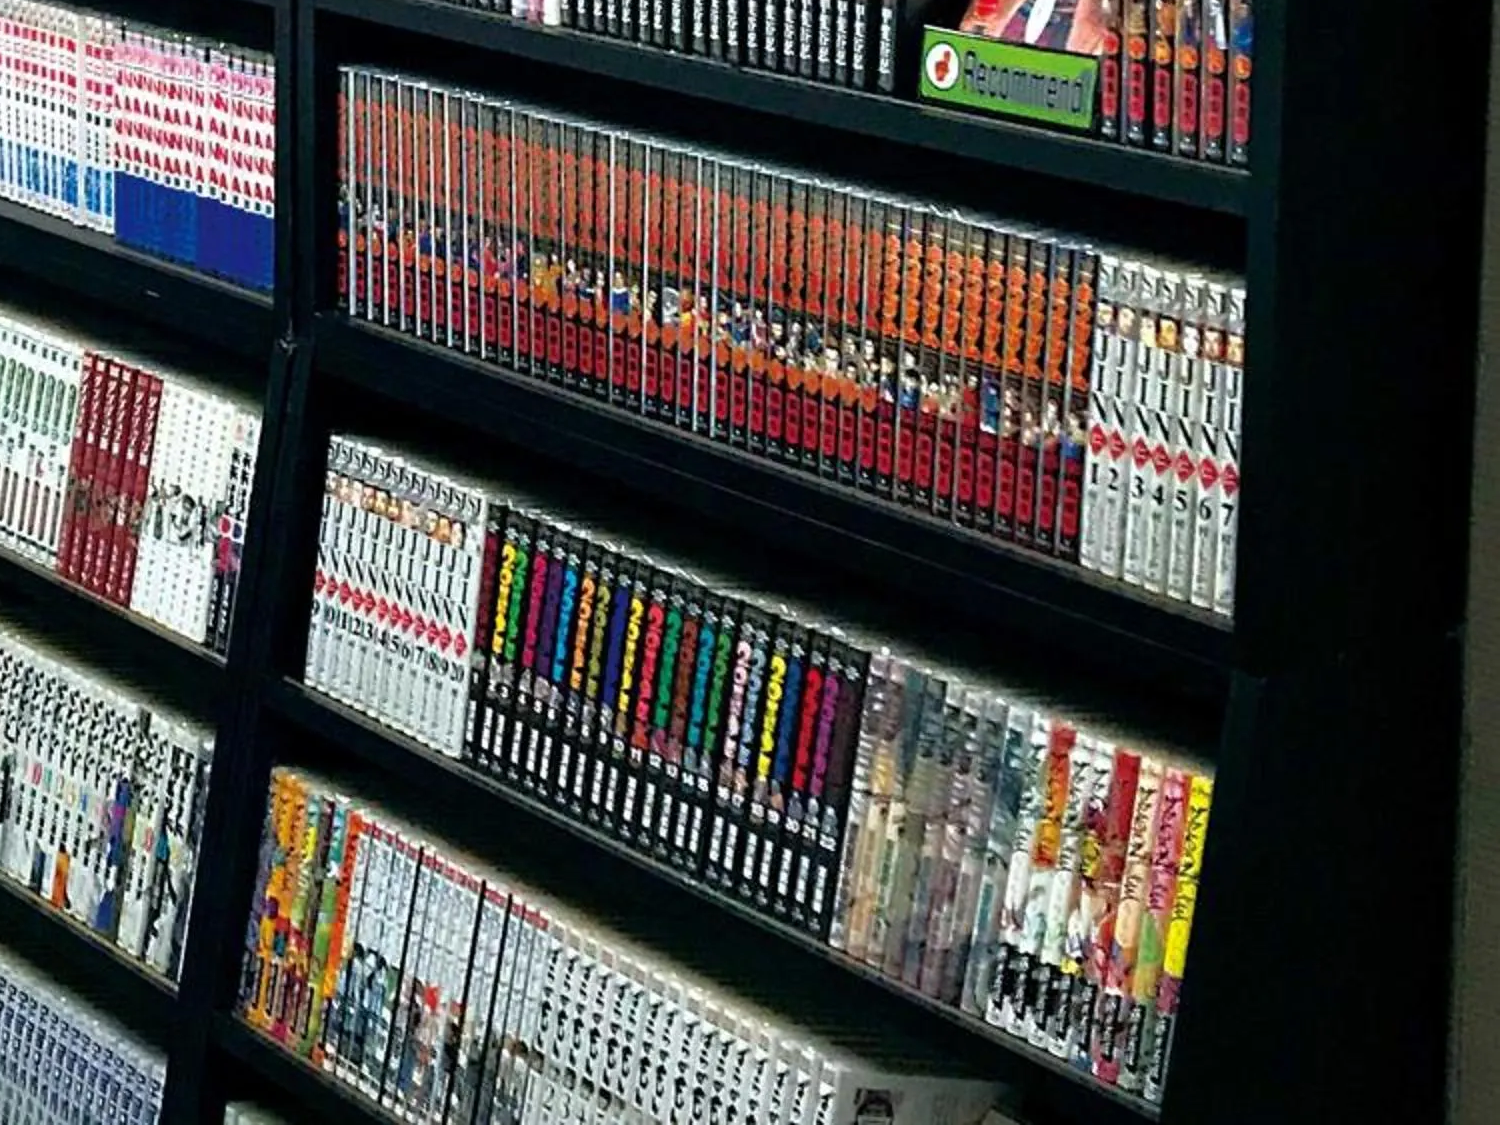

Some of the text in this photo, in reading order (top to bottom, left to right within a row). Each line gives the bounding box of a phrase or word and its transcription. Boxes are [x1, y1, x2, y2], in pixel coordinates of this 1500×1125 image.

[964, 50, 1082, 114] Recommend
[1092, 334, 1109, 423] JIN
[1112, 340, 1128, 428] JIN
[1134, 347, 1151, 436] JIN
[1155, 353, 1172, 442] JIN
[1178, 359, 1195, 449] JIN
[1201, 364, 1218, 455] JIN
[1224, 371, 1240, 462] JIN
[1091, 462, 1098, 485] 1
[1108, 468, 1118, 491] 2
[1131, 476, 1144, 499] 3
[1152, 485, 1164, 506] 4
[1175, 490, 1187, 512] 5
[1199, 497, 1212, 520] 6
[1222, 503, 1234, 526] 7
